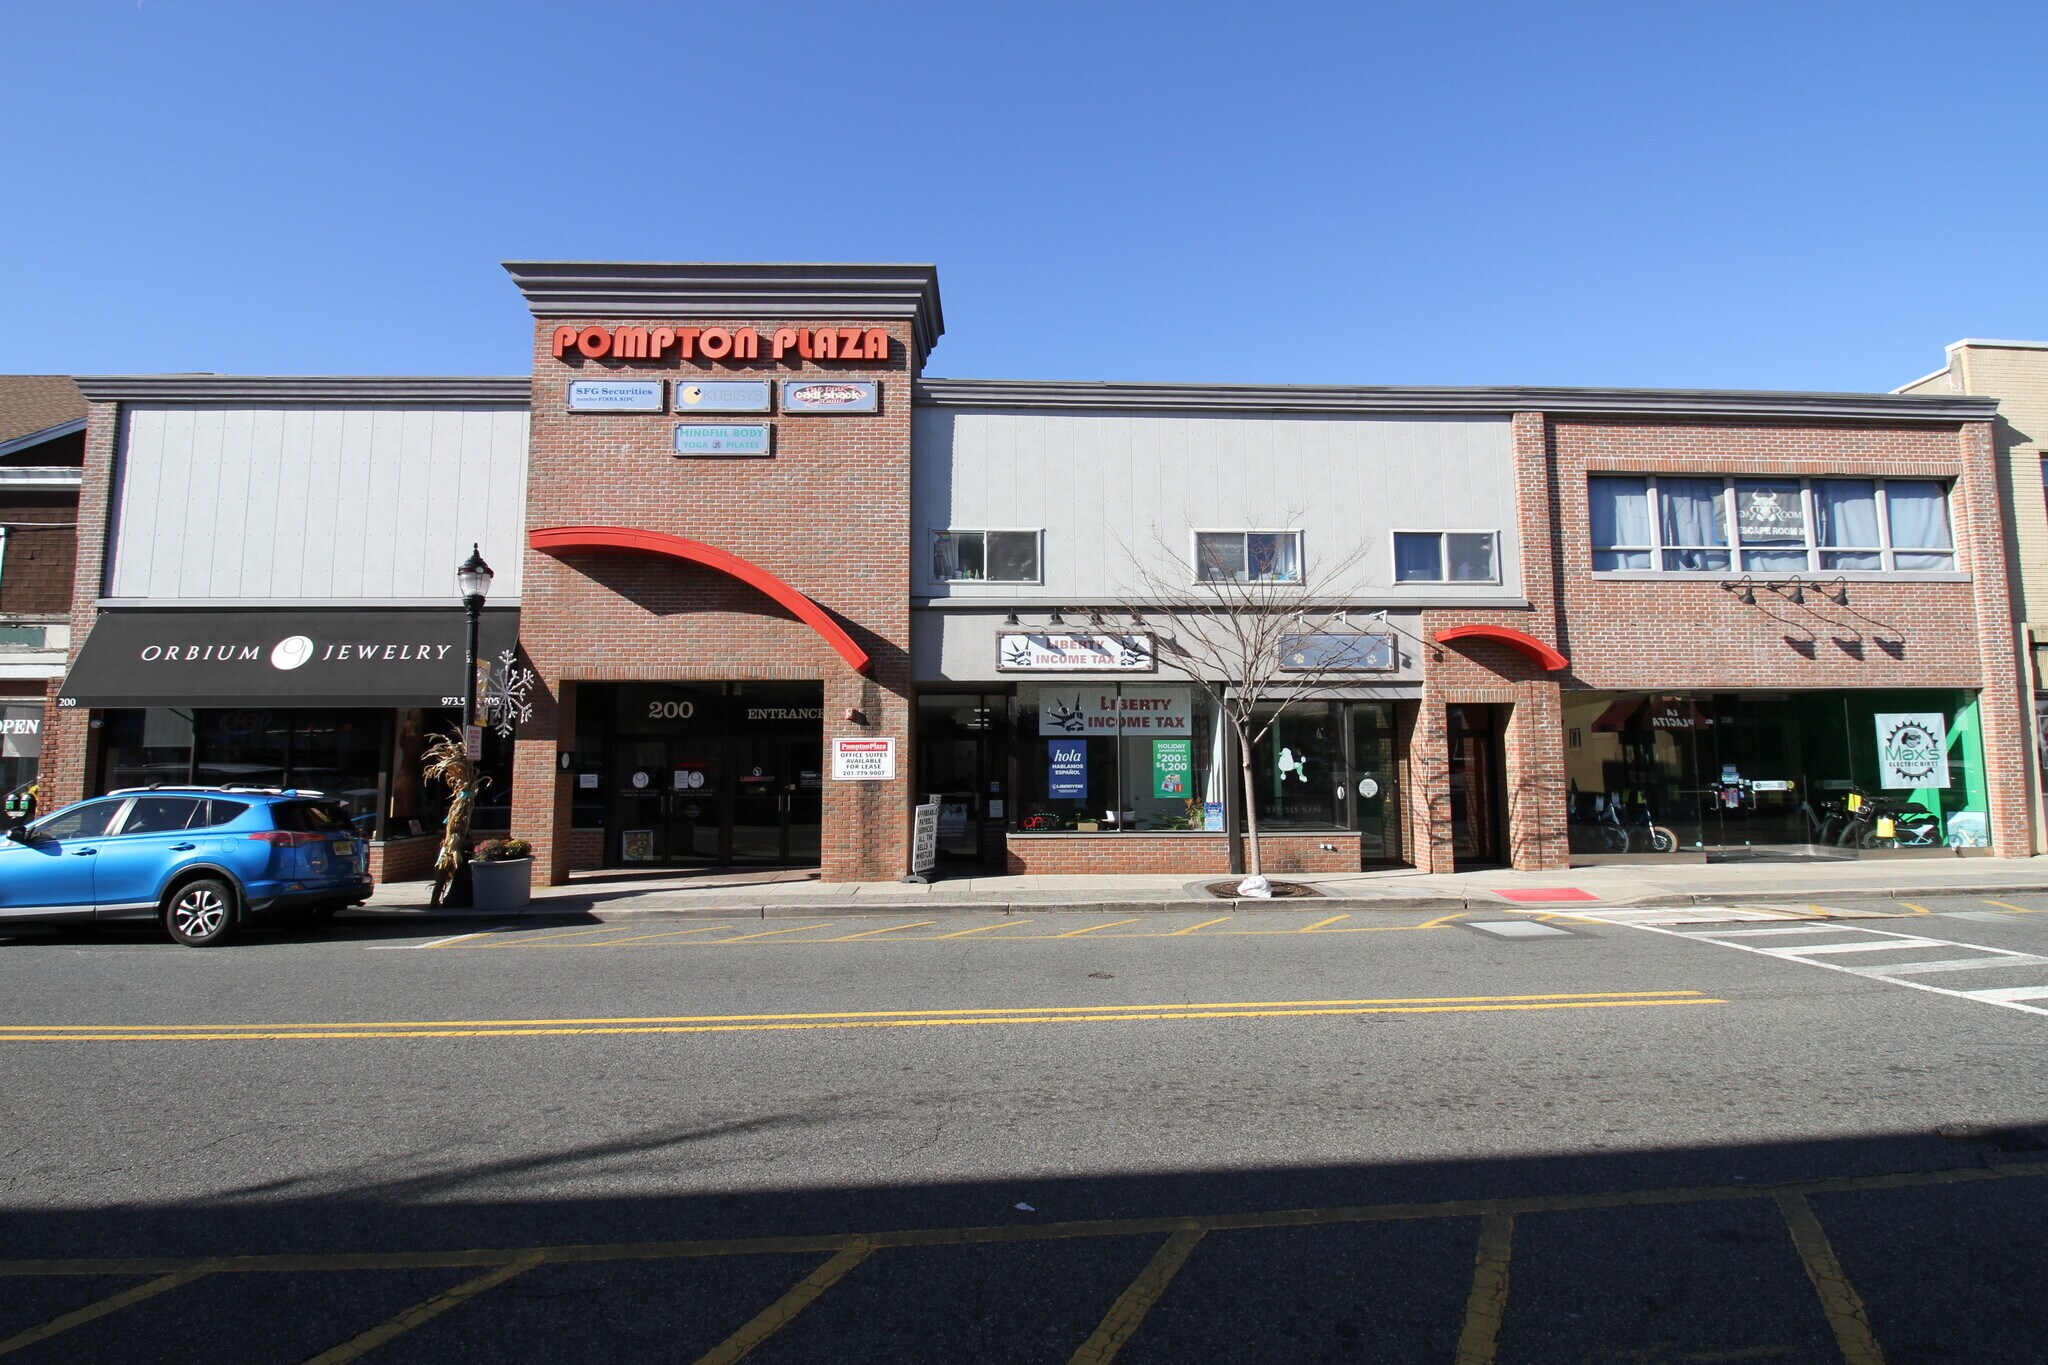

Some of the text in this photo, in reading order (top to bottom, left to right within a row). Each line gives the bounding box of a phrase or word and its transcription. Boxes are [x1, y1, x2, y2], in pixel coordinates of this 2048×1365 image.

[552, 325, 888, 359] POMPTON PLAZA
[576, 387, 653, 395] SFG Securities
[703, 389, 764, 402] KUBISYS
[680, 428, 764, 438] MINDFUL BODY
[684, 441, 759, 449] YOGA PILATES
[1772, 526, 1798, 536] ROOM
[1046, 640, 1105, 650] LIBERTY
[141, 645, 260, 661] ORBIUM
[323, 645, 452, 661] JEWELRY
[1036, 654, 1116, 664] INCOME TAX
[58, 698, 77, 707] 200
[1100, 696, 1172, 711] LIBERTY
[649, 701, 694, 719] 200
[0, 719, 40, 735] PEN
[1088, 716, 1185, 728] INCOME TAX
[1054, 749, 1082, 762] hola
[1157, 753, 1181, 762] $200
[1885, 744, 1941, 761] Max's
